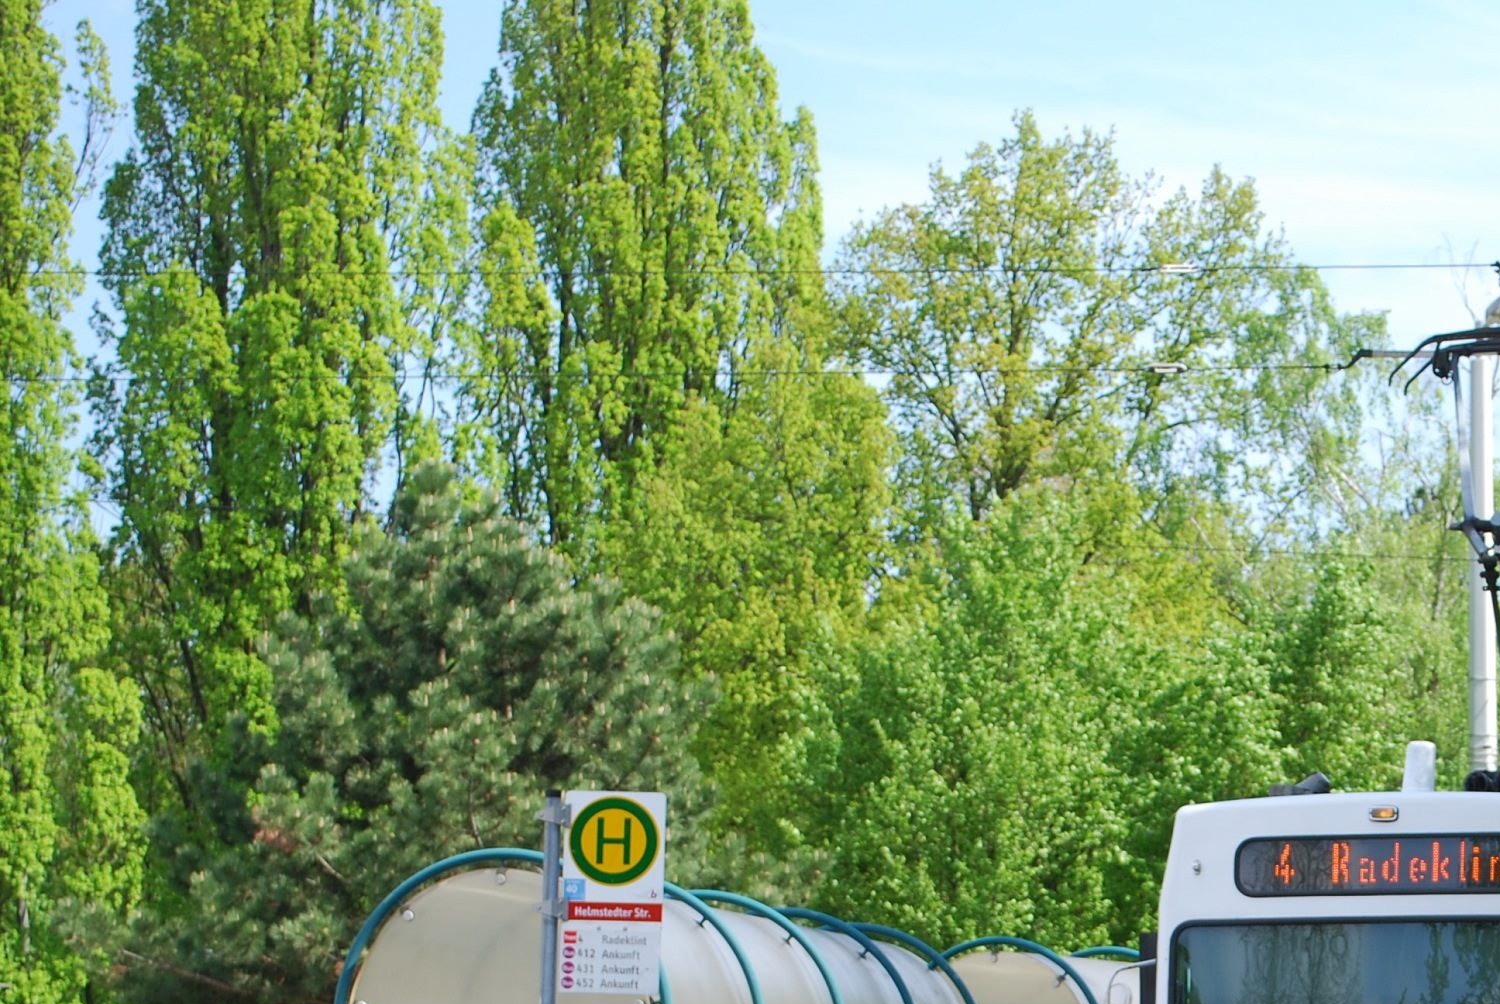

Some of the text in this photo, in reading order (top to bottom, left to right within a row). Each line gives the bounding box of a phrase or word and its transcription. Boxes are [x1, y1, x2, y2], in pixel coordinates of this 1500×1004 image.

[596, 817, 632, 865] H
[1273, 842, 1296, 885] 4
[574, 905, 652, 919] Helmstedter Str.
[601, 934, 647, 945] Radeklint
[577, 948, 596, 959] 412
[601, 949, 641, 960] Ankunft
[576, 964, 595, 974] 431
[601, 964, 640, 975] Ankunft
[576, 979, 594, 989] 452
[600, 980, 639, 990] Ankunft
